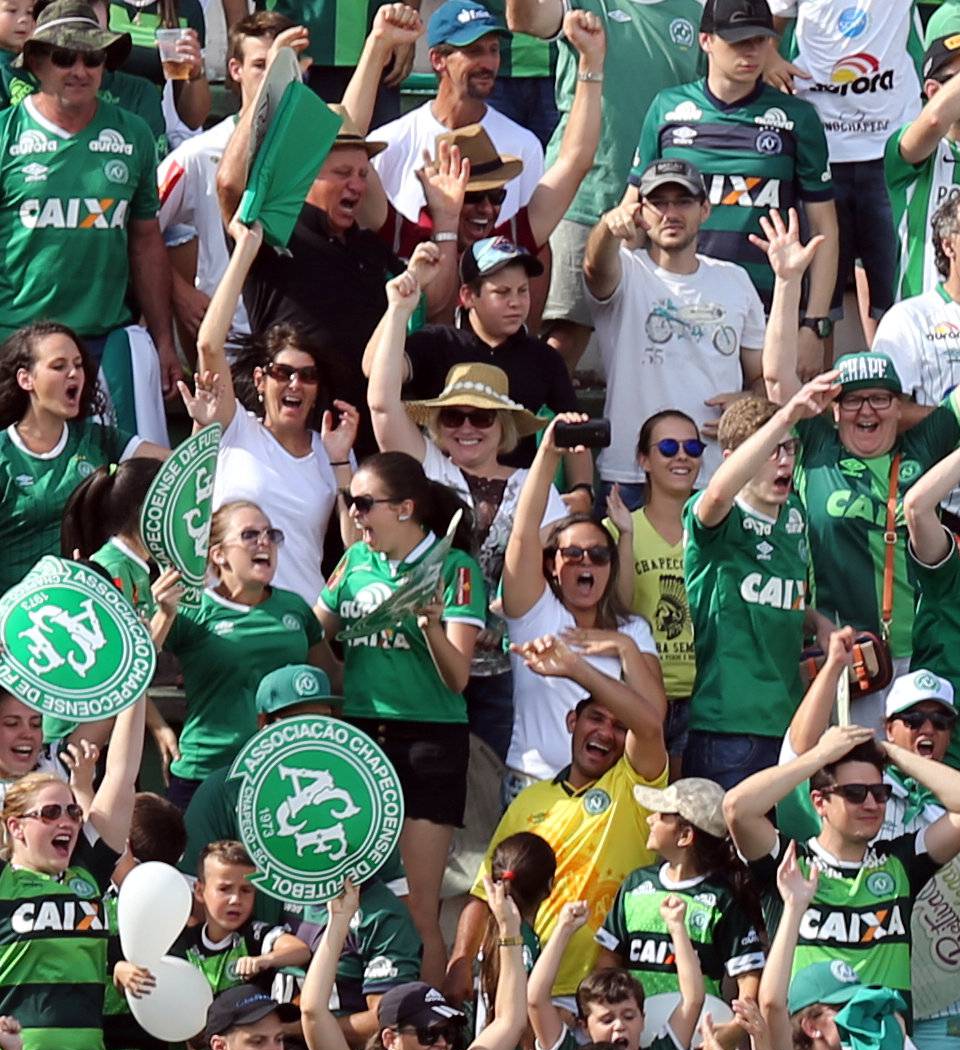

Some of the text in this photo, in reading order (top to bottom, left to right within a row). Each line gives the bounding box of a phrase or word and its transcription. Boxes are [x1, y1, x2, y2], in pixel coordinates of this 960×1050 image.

[10, 141, 57, 156] aurora
[89, 139, 133, 155] aurora
[701, 174, 779, 208] IXA
[20, 198, 128, 228] CAIXA
[841, 357, 887, 383] CHAPE
[16, 678, 42, 700] DE
[348, 737, 400, 866] CHAPECOENSE
[258, 807, 275, 839] 1973
[346, 859, 374, 883] DE
[11, 901, 109, 934] CAIX
[799, 905, 905, 943] CAIXA
